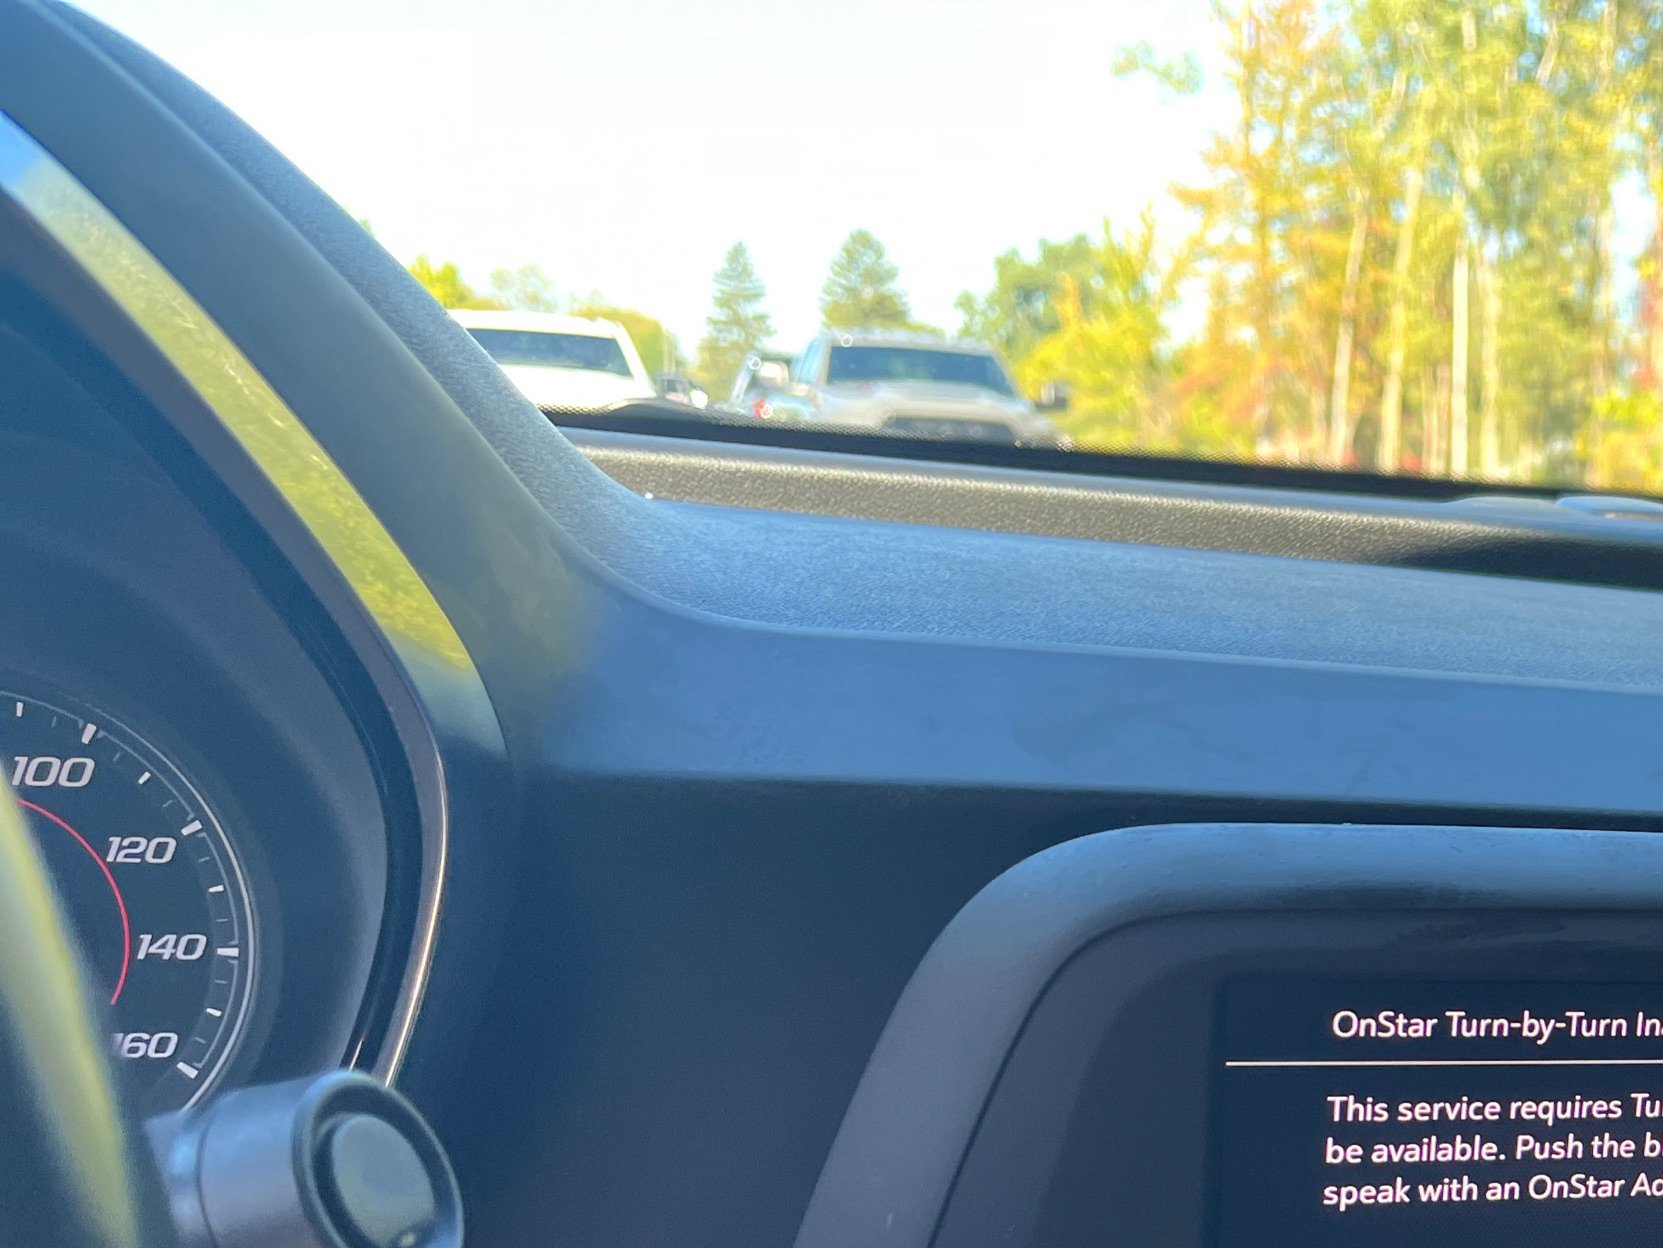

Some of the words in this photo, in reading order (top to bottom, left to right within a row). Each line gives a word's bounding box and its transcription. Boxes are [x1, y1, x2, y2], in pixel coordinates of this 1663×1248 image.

[12, 756, 95, 788] 100
[105, 836, 177, 864] 120
[136, 933, 207, 961] 140
[1332, 1009, 1438, 1038] OnStar
[1445, 1011, 1628, 1045] Turn-by-Turn
[1326, 1094, 1389, 1123] This
[1396, 1095, 1502, 1122] service
[1509, 1094, 1623, 1131] requires
[1325, 1136, 1364, 1165] be
[1370, 1134, 1506, 1164] available.
[1515, 1132, 1584, 1161] Push
[1590, 1132, 1636, 1159] the
[1322, 1176, 1411, 1212] speak
[1417, 1175, 1479, 1203] with
[1485, 1180, 1520, 1202] an
[1528, 1172, 1626, 1201] OnStar
